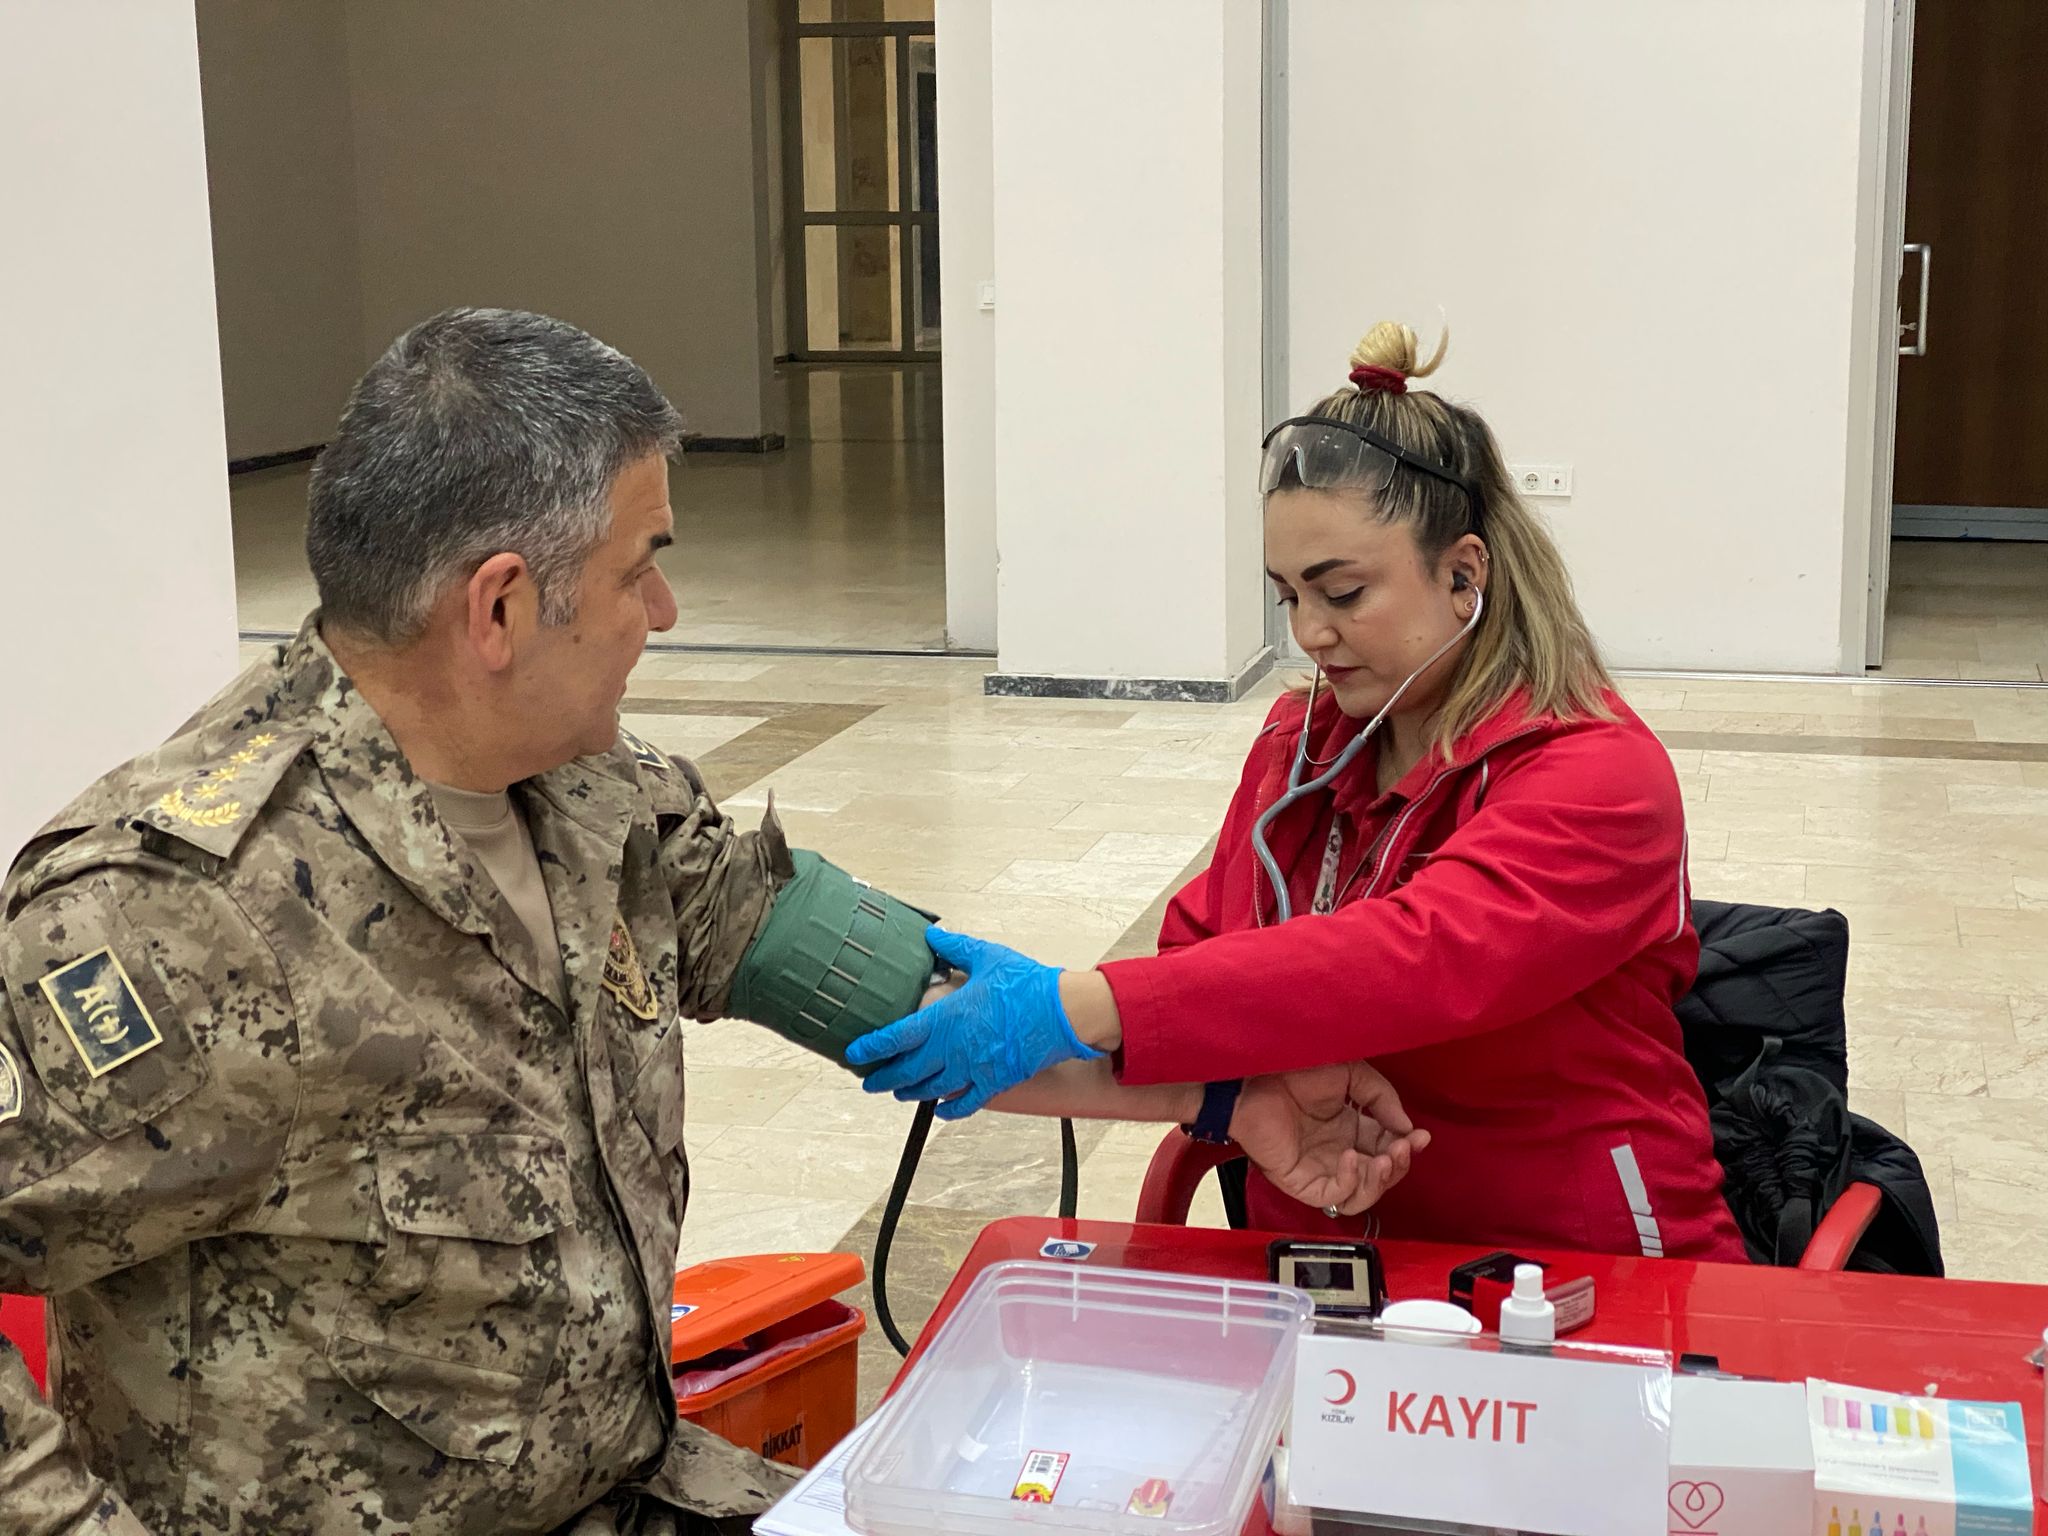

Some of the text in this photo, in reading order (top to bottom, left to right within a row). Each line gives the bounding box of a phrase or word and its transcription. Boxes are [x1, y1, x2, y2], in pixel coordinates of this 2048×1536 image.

[74, 984, 130, 1045] A(+)
[1321, 1412, 1355, 1424] KIZILAY
[1387, 1390, 1538, 1444] KAYIT
